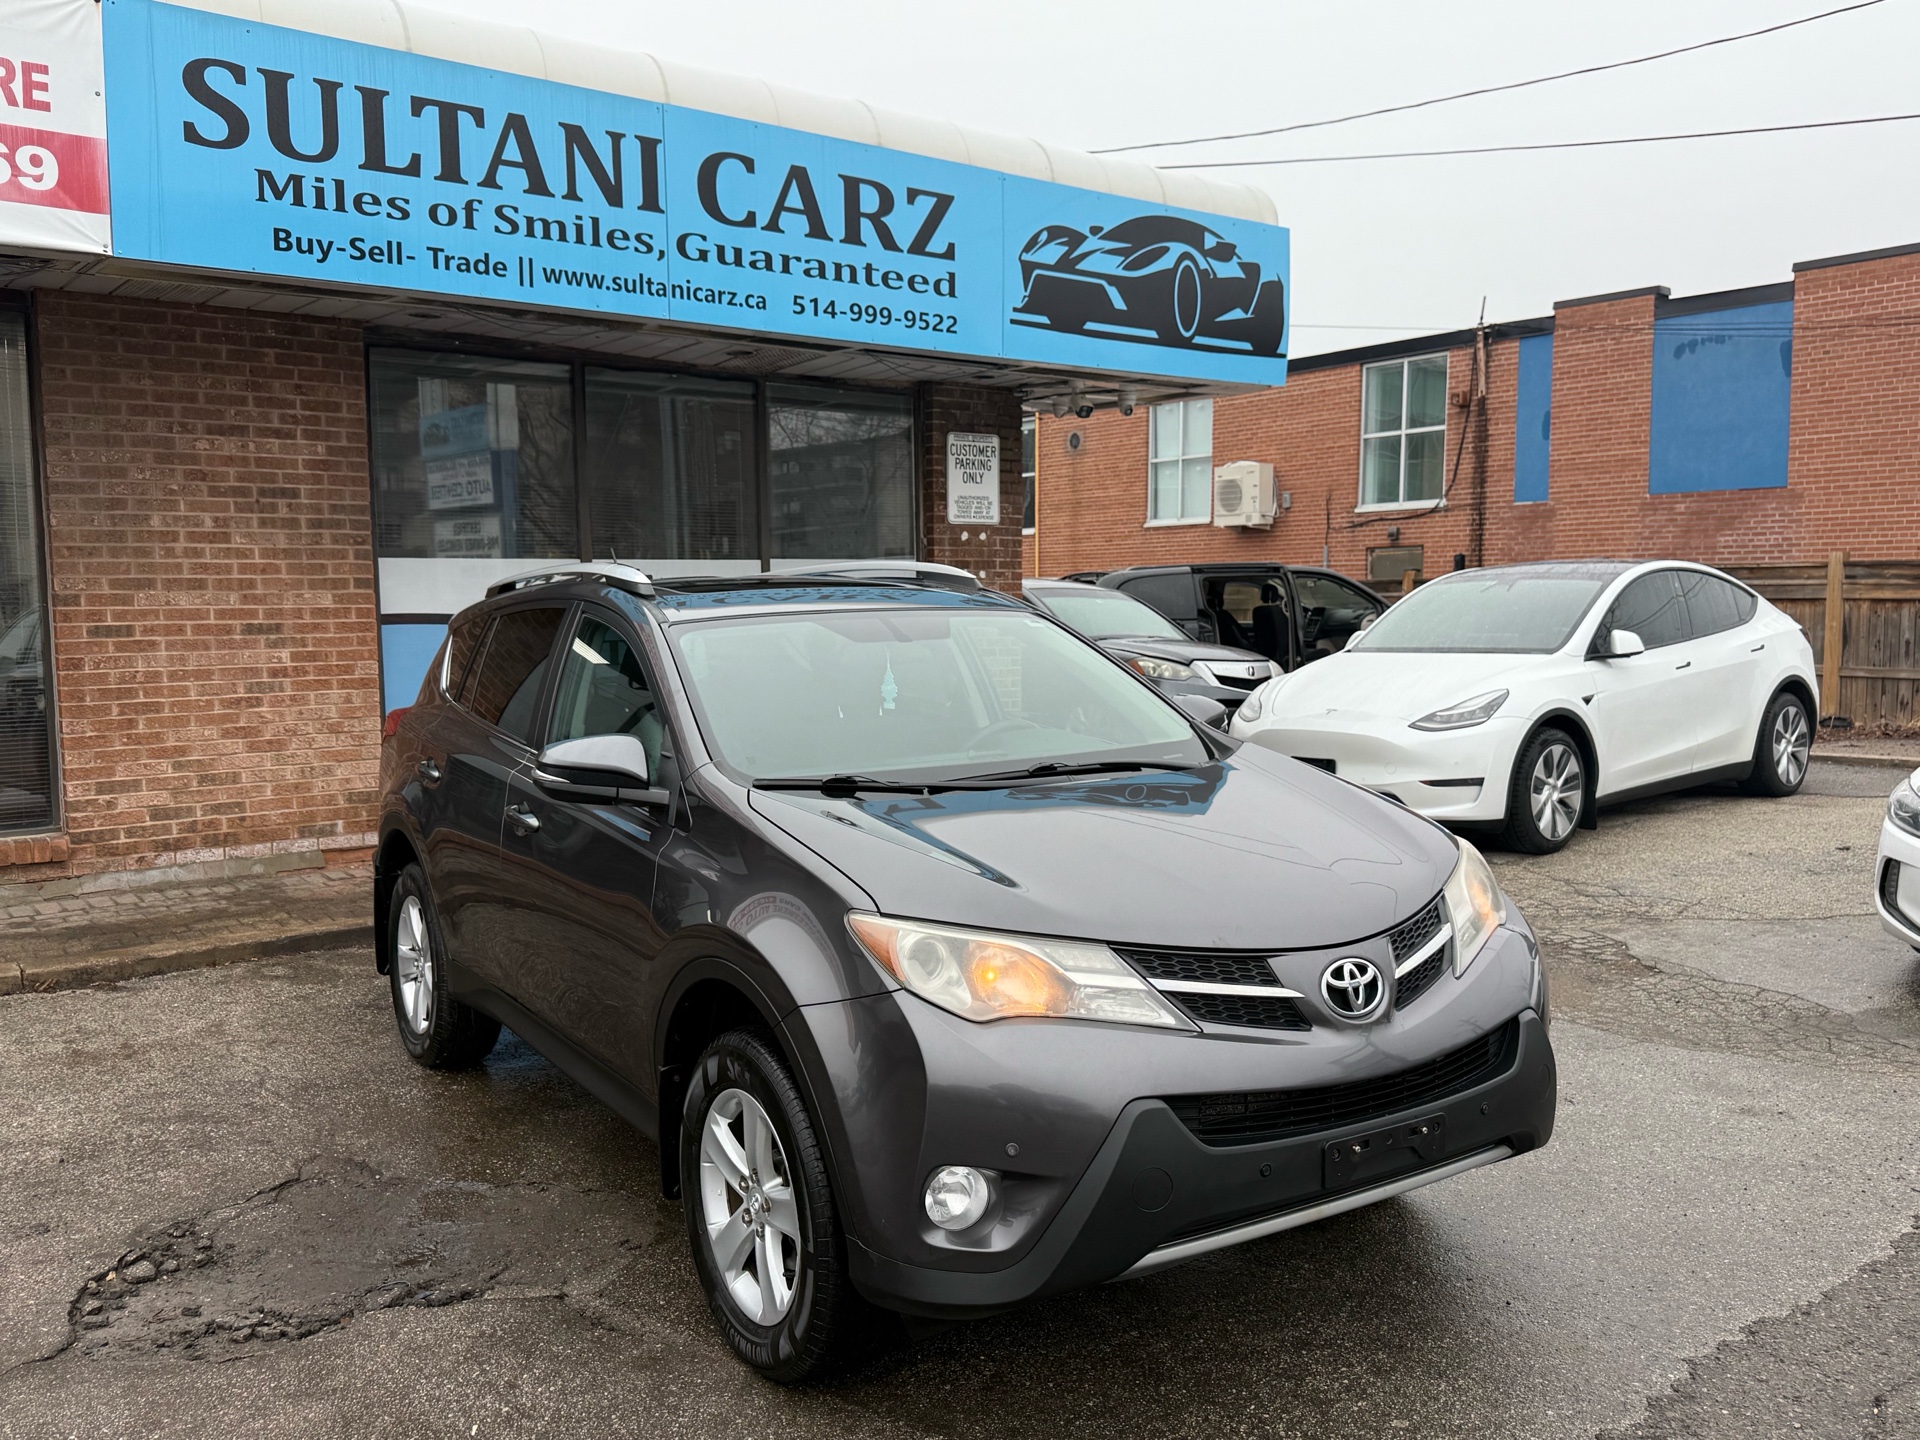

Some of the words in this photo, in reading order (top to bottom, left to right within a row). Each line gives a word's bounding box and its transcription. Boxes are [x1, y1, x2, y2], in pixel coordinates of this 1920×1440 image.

[0, 142, 59, 191] 9
[182, 57, 665, 214] SULTANI
[696, 151, 956, 262] CARZ
[254, 168, 411, 221] Miles
[428, 198, 483, 231] of
[494, 204, 666, 262] Smiles,
[676, 232, 957, 299] Guaranteed
[426, 246, 508, 278] Trade
[542, 266, 767, 311] www.sultanicarz.ca
[792, 294, 958, 334] 514-999-9522
[950, 443, 996, 458] CUSTOMER
[955, 457, 992, 471] PARKING
[962, 471, 984, 484] ONLY
